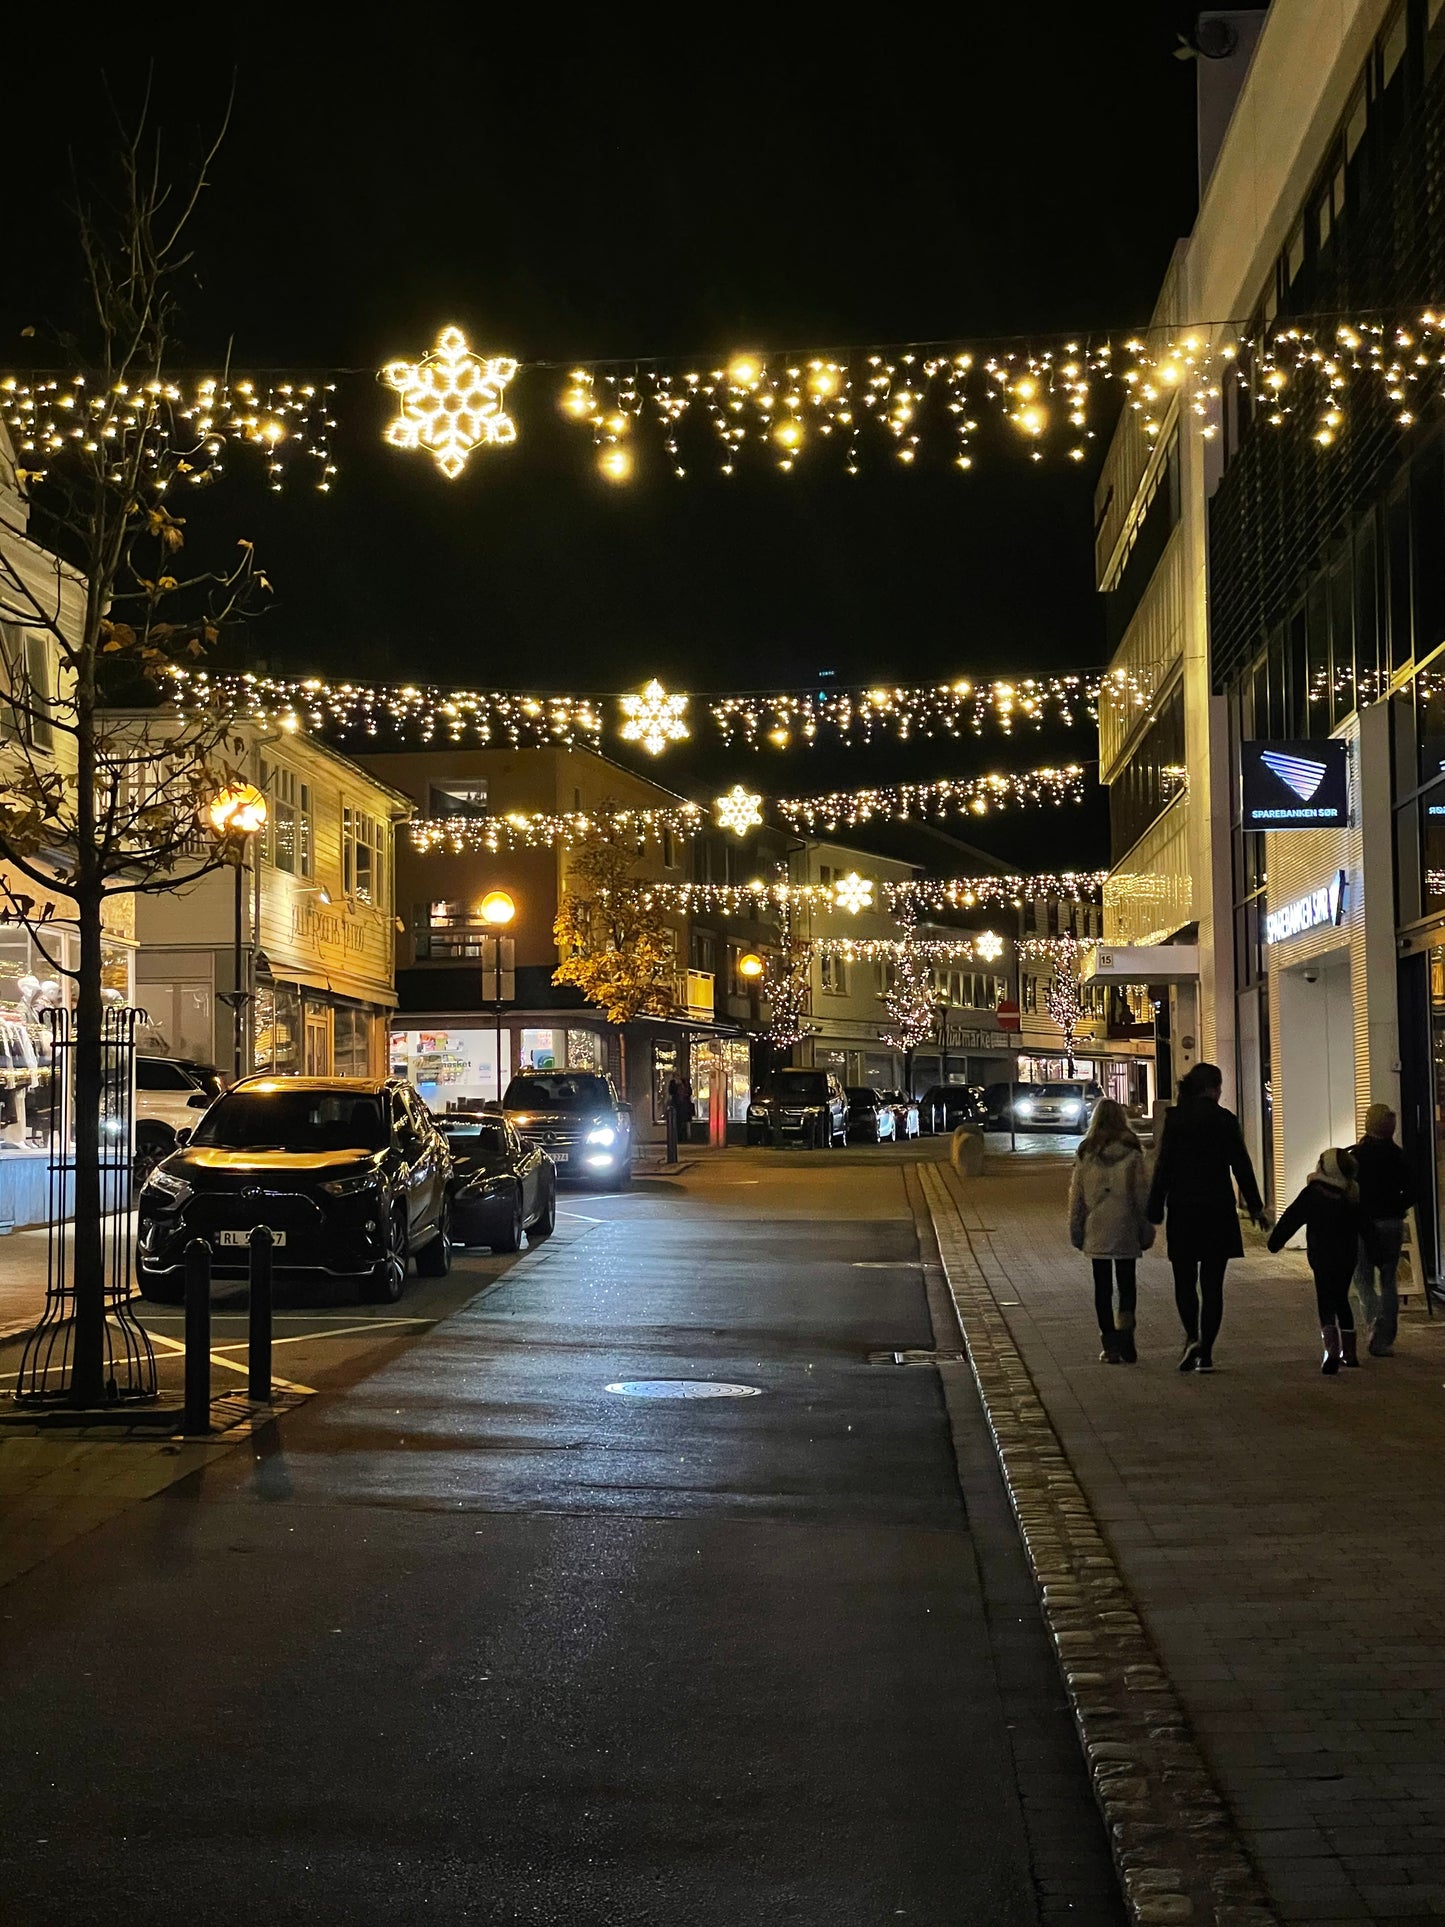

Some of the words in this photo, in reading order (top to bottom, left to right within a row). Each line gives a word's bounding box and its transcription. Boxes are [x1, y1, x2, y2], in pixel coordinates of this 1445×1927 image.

[1252, 809, 1317, 818] SPAREBANKEN
[1318, 808, 1338, 817] SØR
[1101, 956, 1112, 965] 15
[224, 1232, 238, 1245] RL
